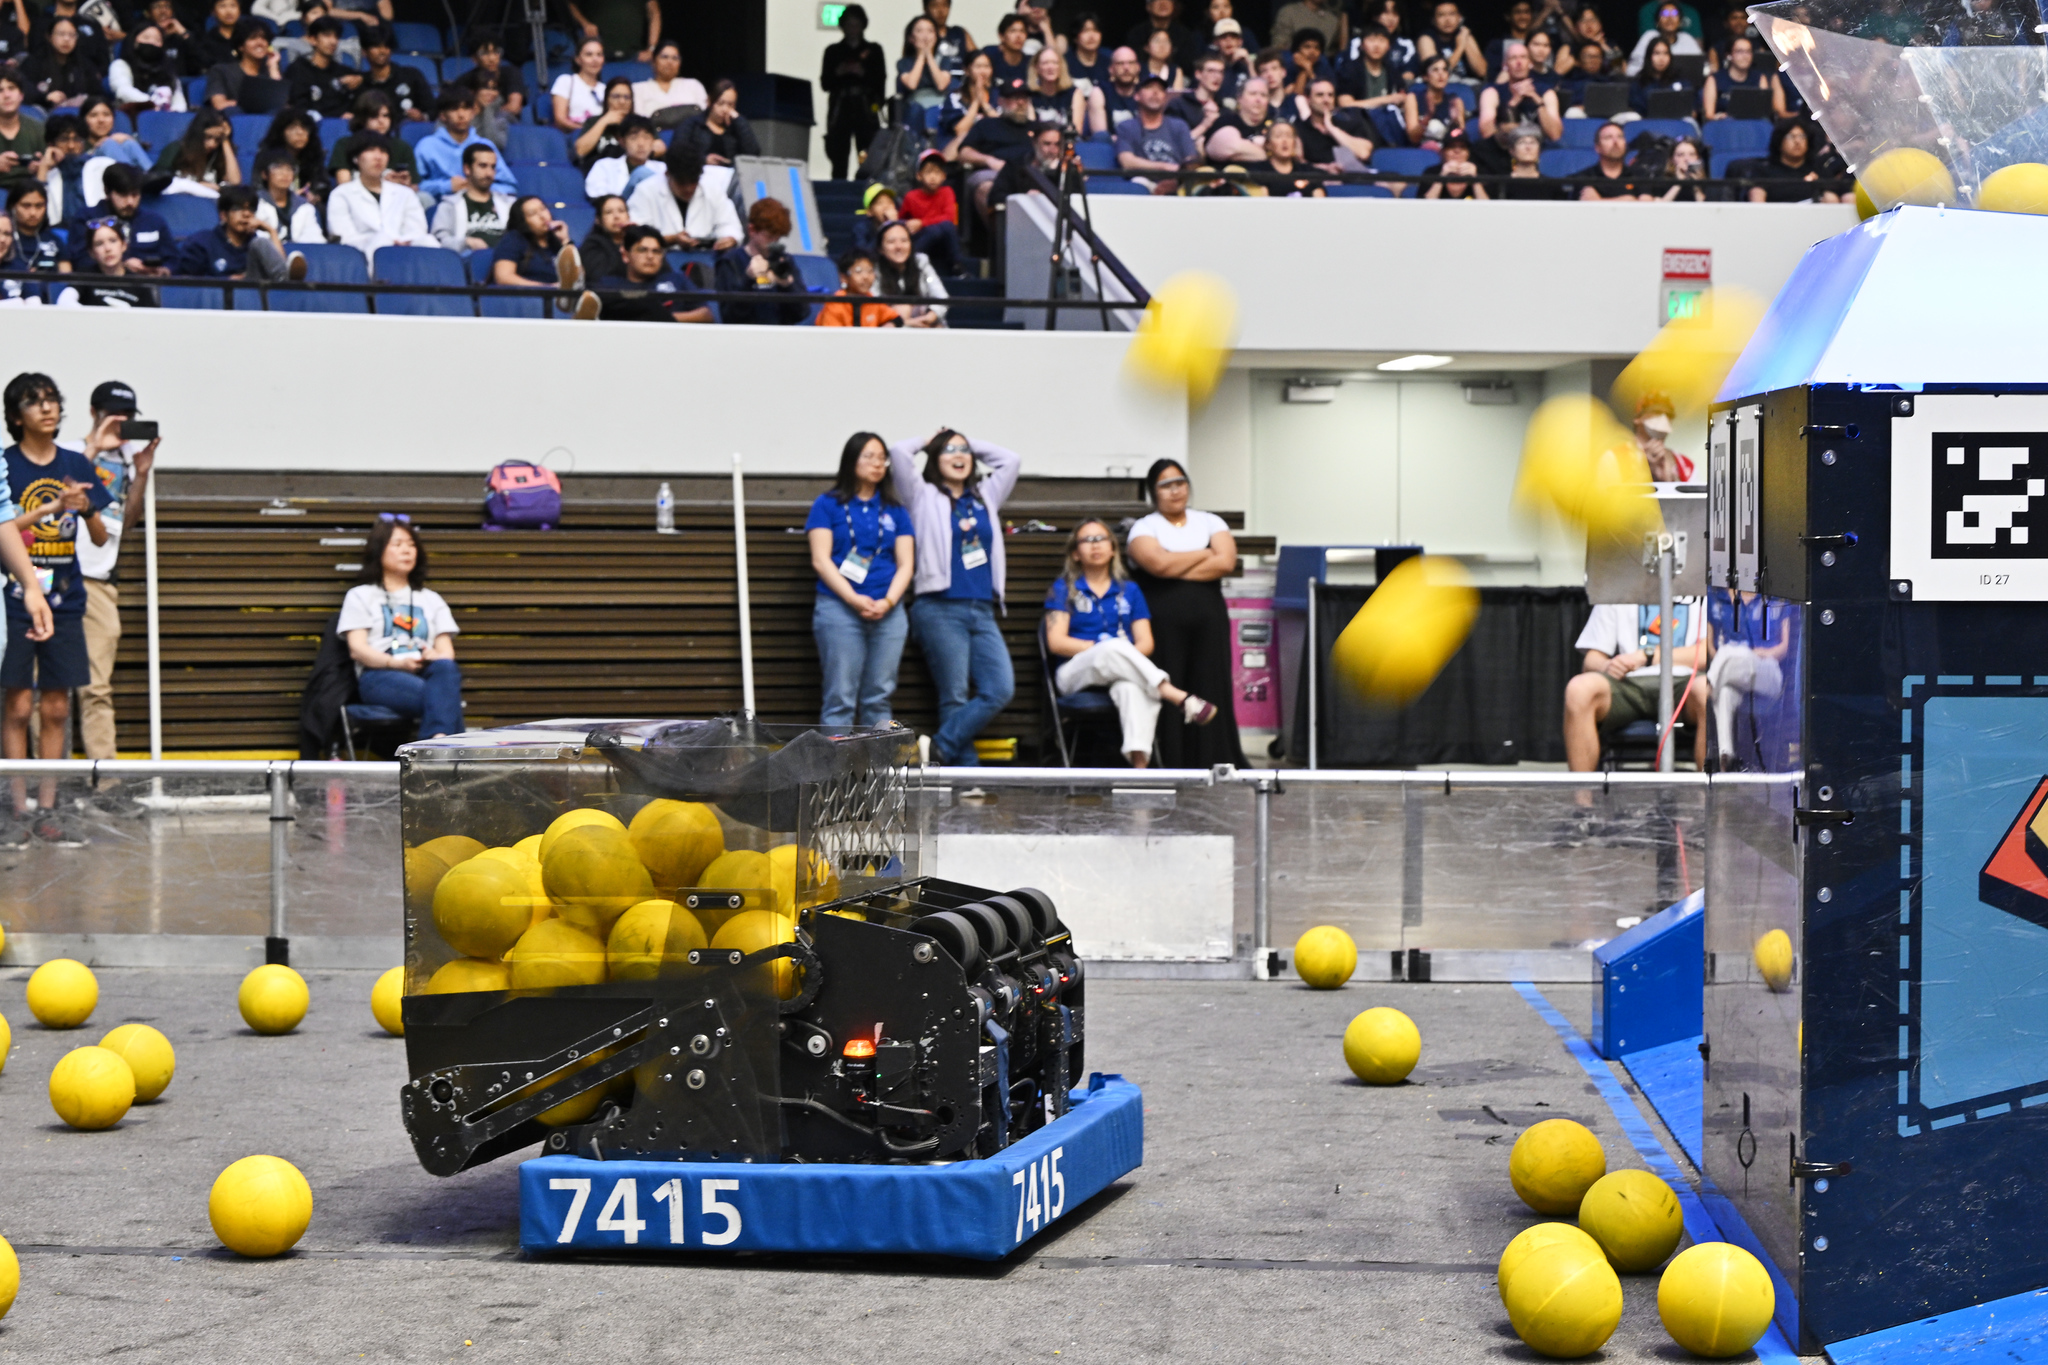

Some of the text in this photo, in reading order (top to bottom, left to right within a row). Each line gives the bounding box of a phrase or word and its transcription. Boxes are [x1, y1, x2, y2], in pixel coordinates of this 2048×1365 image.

[1979, 574, 2010, 585] ID 27
[549, 1178, 743, 1246] 7415
[1013, 1145, 1066, 1243] 7415
